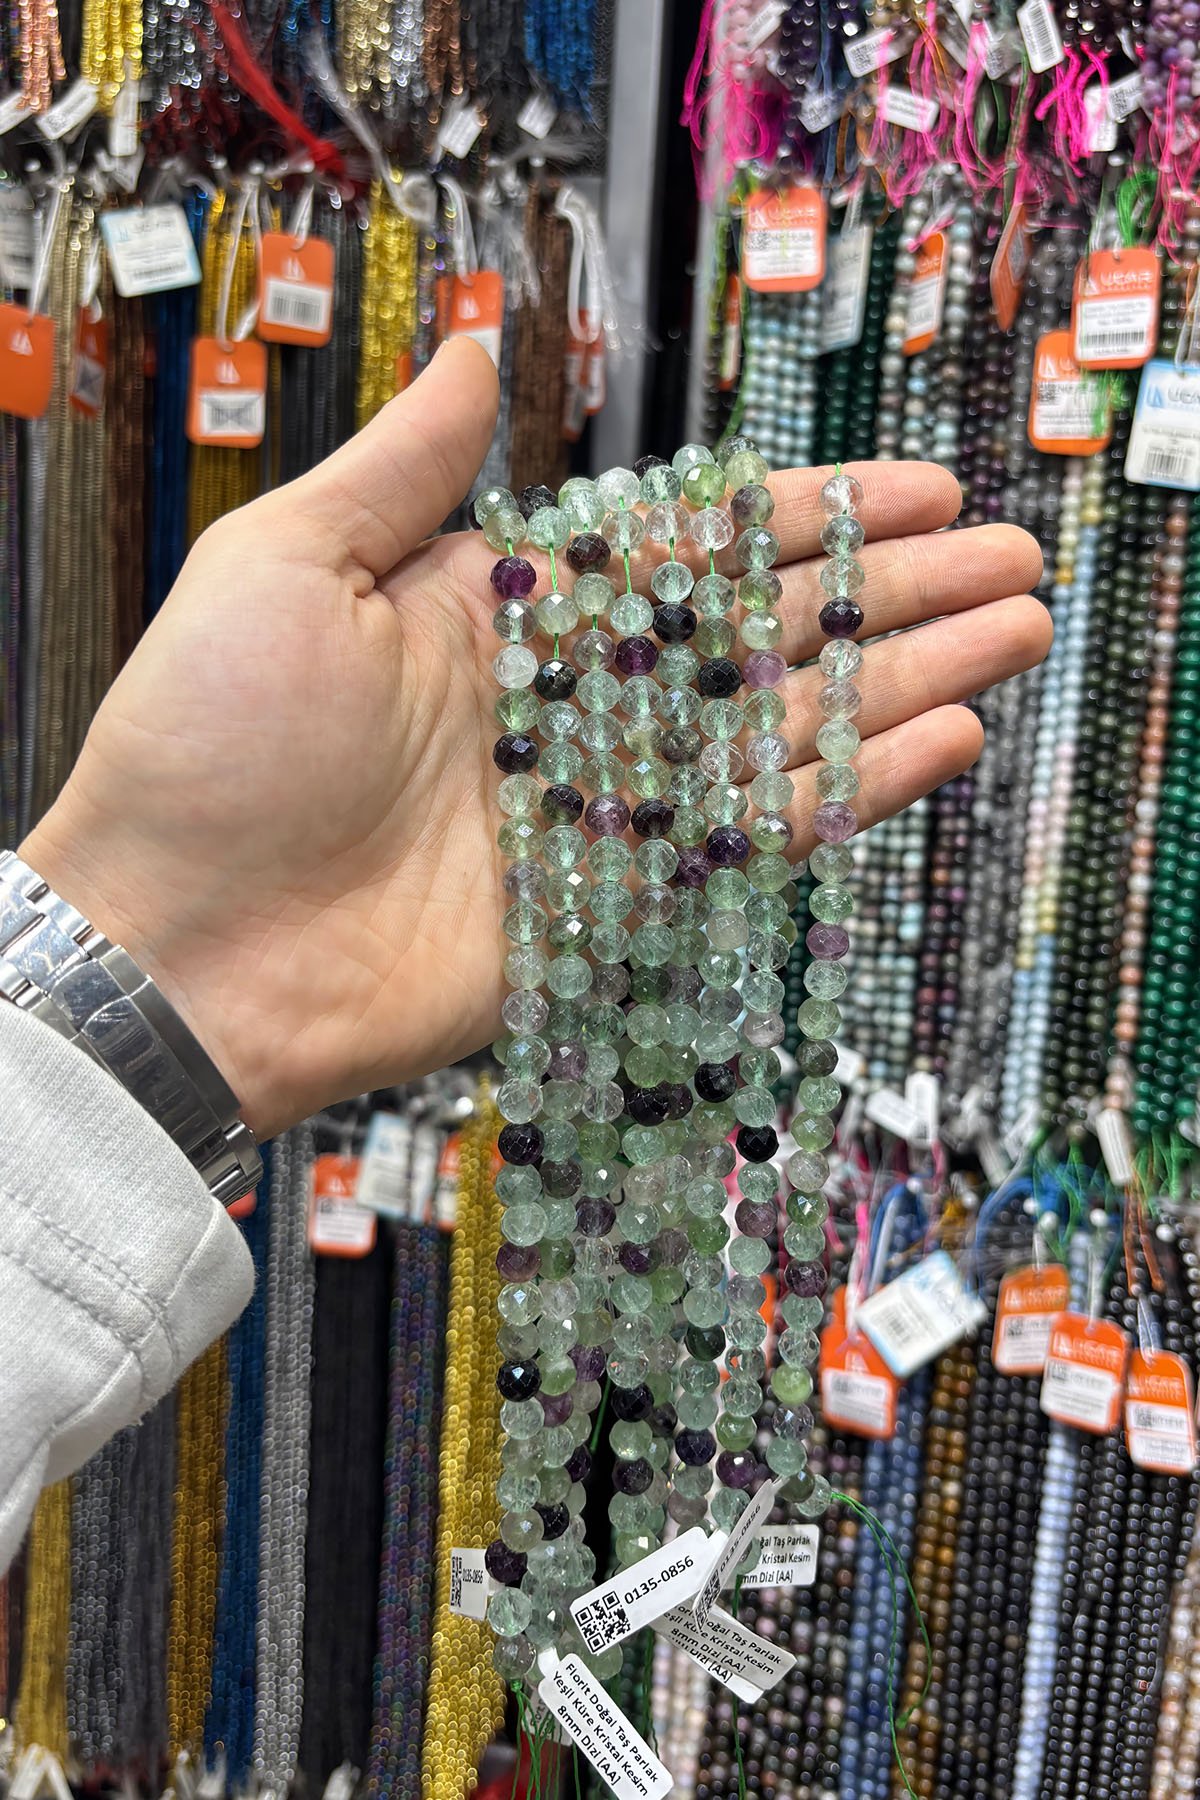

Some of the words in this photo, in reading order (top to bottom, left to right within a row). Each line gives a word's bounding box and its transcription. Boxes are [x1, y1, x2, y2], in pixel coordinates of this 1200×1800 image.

[719, 1503, 761, 1572] 0135-0856
[761, 1552, 787, 1564] Kristal
[788, 1552, 811, 1563] Kesim
[773, 1536, 786, 1548] Taş
[787, 1535, 811, 1546] Parlak
[624, 1555, 694, 1604] 0135-0856
[742, 1574, 758, 1584] mm
[759, 1571, 775, 1583] Dizi
[776, 1569, 793, 1585] [AA]
[663, 1612, 683, 1624] eşil
[710, 1635, 745, 1657] Kristal
[743, 1653, 775, 1675] Kesim
[671, 1628, 699, 1647] 8mm
[700, 1643, 722, 1658] Dizi
[720, 1654, 746, 1673] [AA]
[705, 1621, 731, 1636] oğal
[731, 1631, 748, 1646] Taş
[748, 1641, 782, 1665] Parlak
[707, 1660, 733, 1683] [AA]
[553, 1671, 575, 1699] Yeşil
[572, 1697, 594, 1727] Küre
[593, 1724, 625, 1763] Kristal
[621, 1760, 648, 1797] Kesim
[557, 1705, 582, 1737] 8mm
[581, 1734, 602, 1759] Dizi
[596, 1756, 621, 1787] [AA]
[565, 1663, 591, 1696] Florit
[589, 1693, 618, 1728] Doğal
[615, 1725, 631, 1748] Taş
[629, 1745, 659, 1783] Parlak
